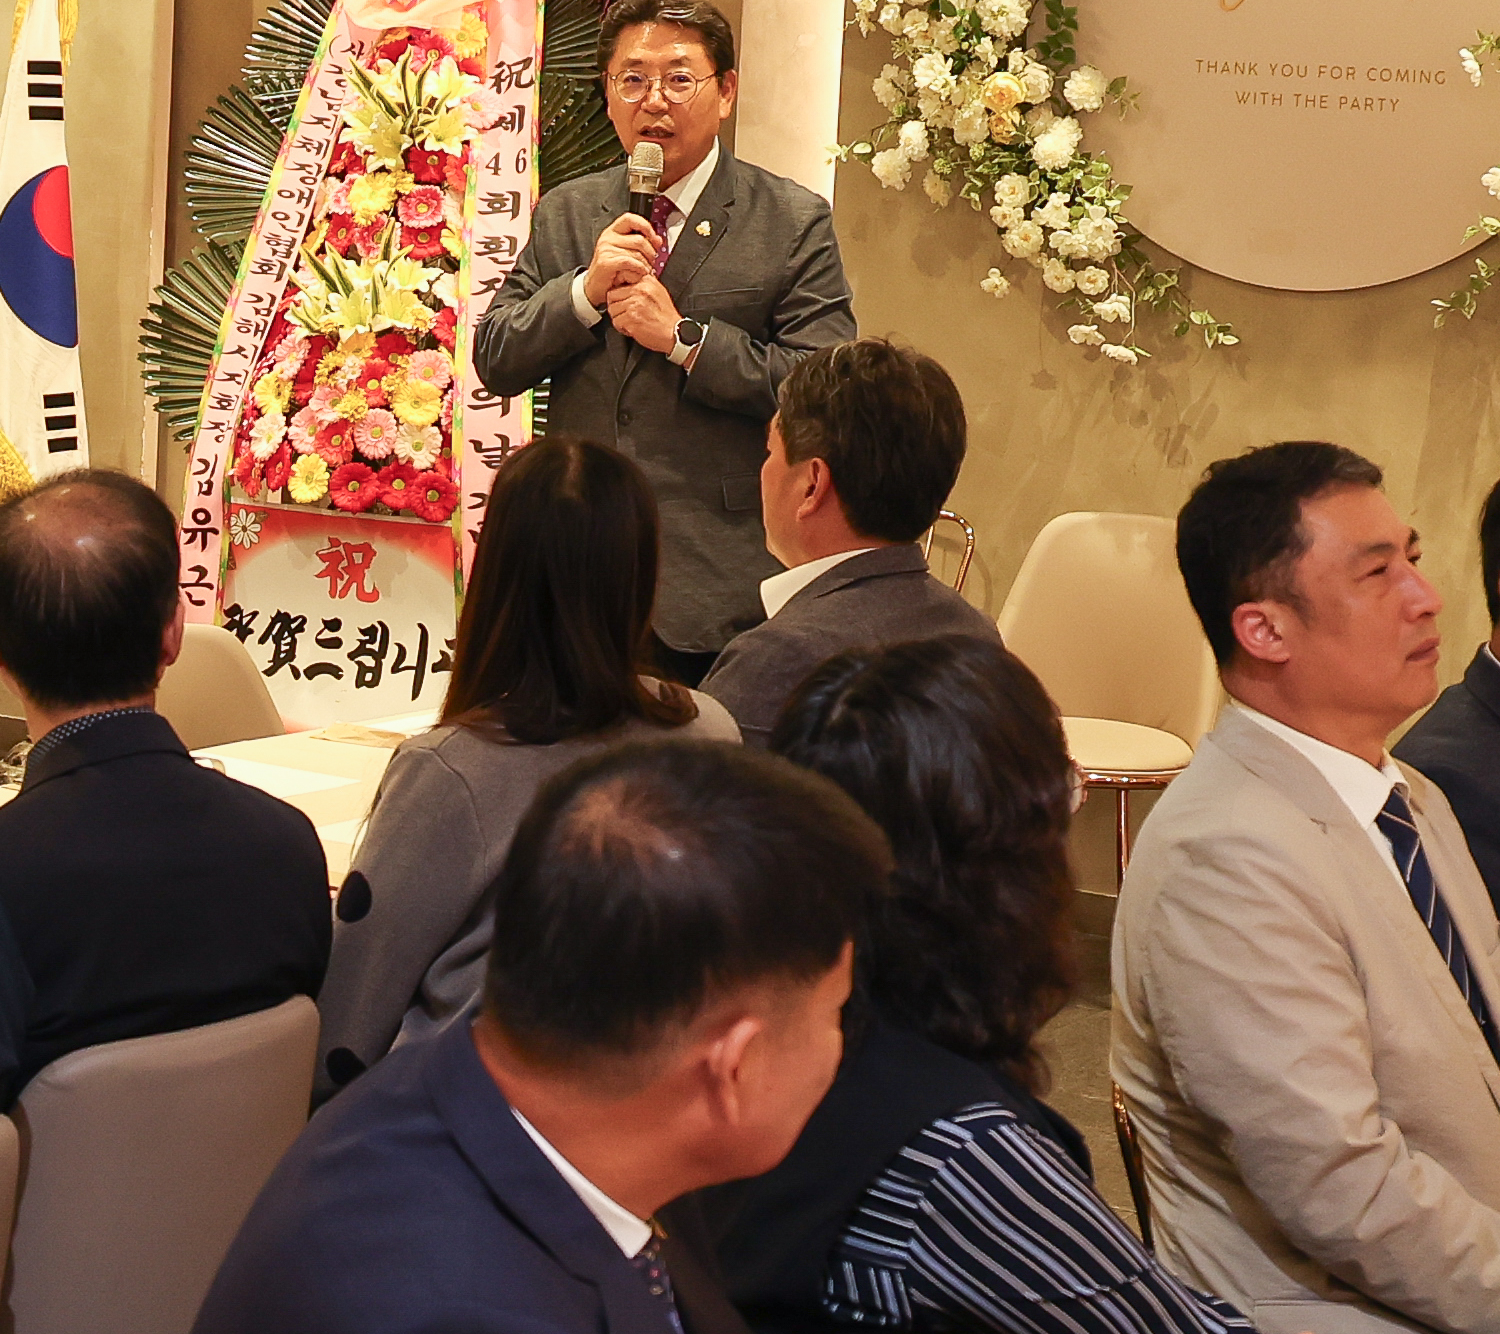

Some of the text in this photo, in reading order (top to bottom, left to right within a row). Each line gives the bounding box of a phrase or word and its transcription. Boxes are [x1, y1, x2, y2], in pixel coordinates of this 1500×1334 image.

[488, 56, 535, 94] 祝
[1195, 58, 1447, 85] THANK YOU FOR COMING
[1235, 90, 1400, 112] WITH THE PARTY
[314, 536, 380, 603] 祝
